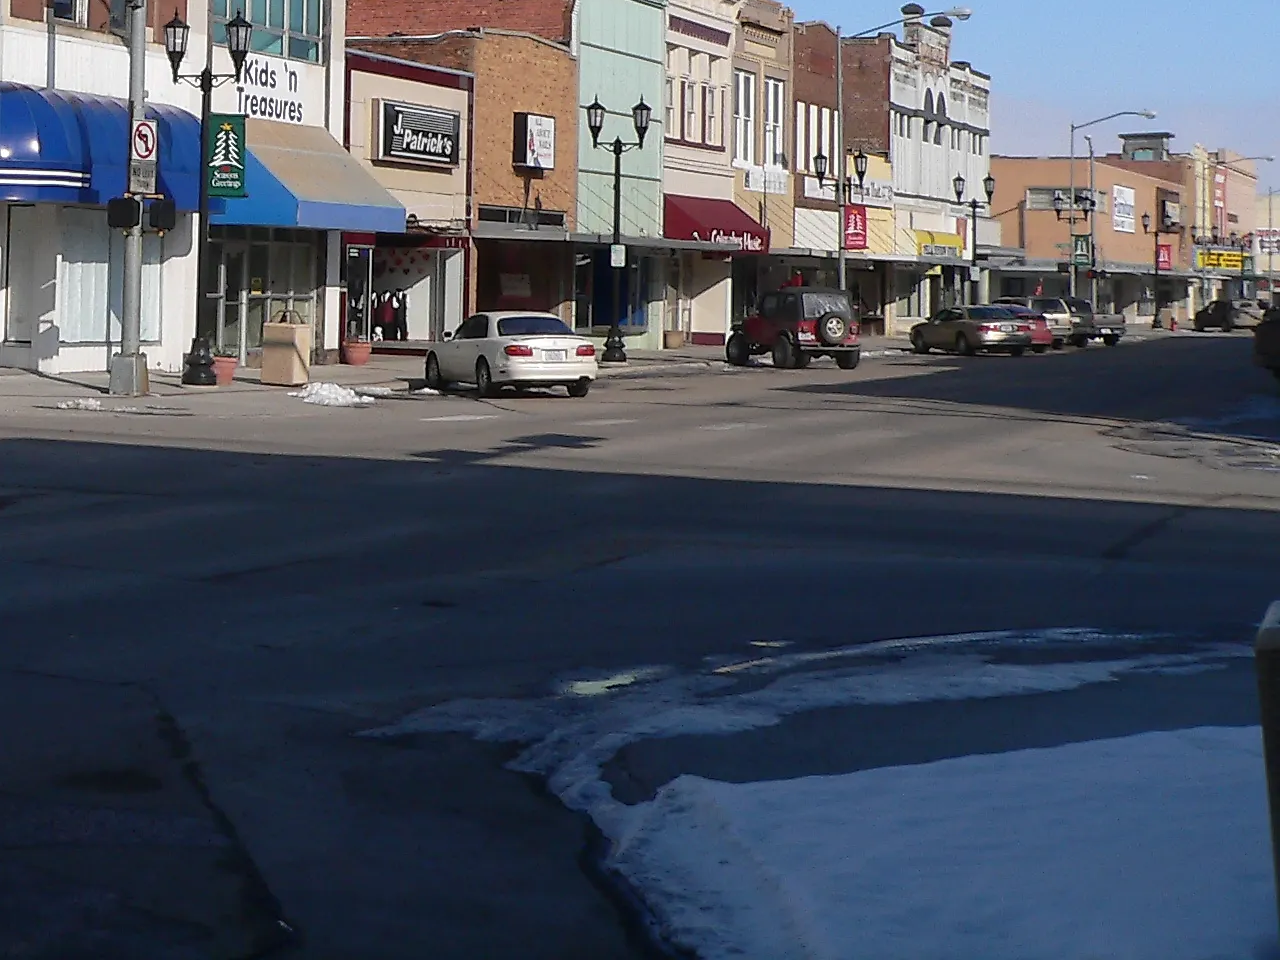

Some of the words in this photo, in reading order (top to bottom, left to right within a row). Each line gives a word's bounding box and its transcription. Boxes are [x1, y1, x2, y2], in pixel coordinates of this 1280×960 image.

[243, 58, 277, 89] Kids
[236, 85, 303, 123] Treasures
[393, 113, 404, 135] J.
[402, 129, 453, 155] Patrick's
